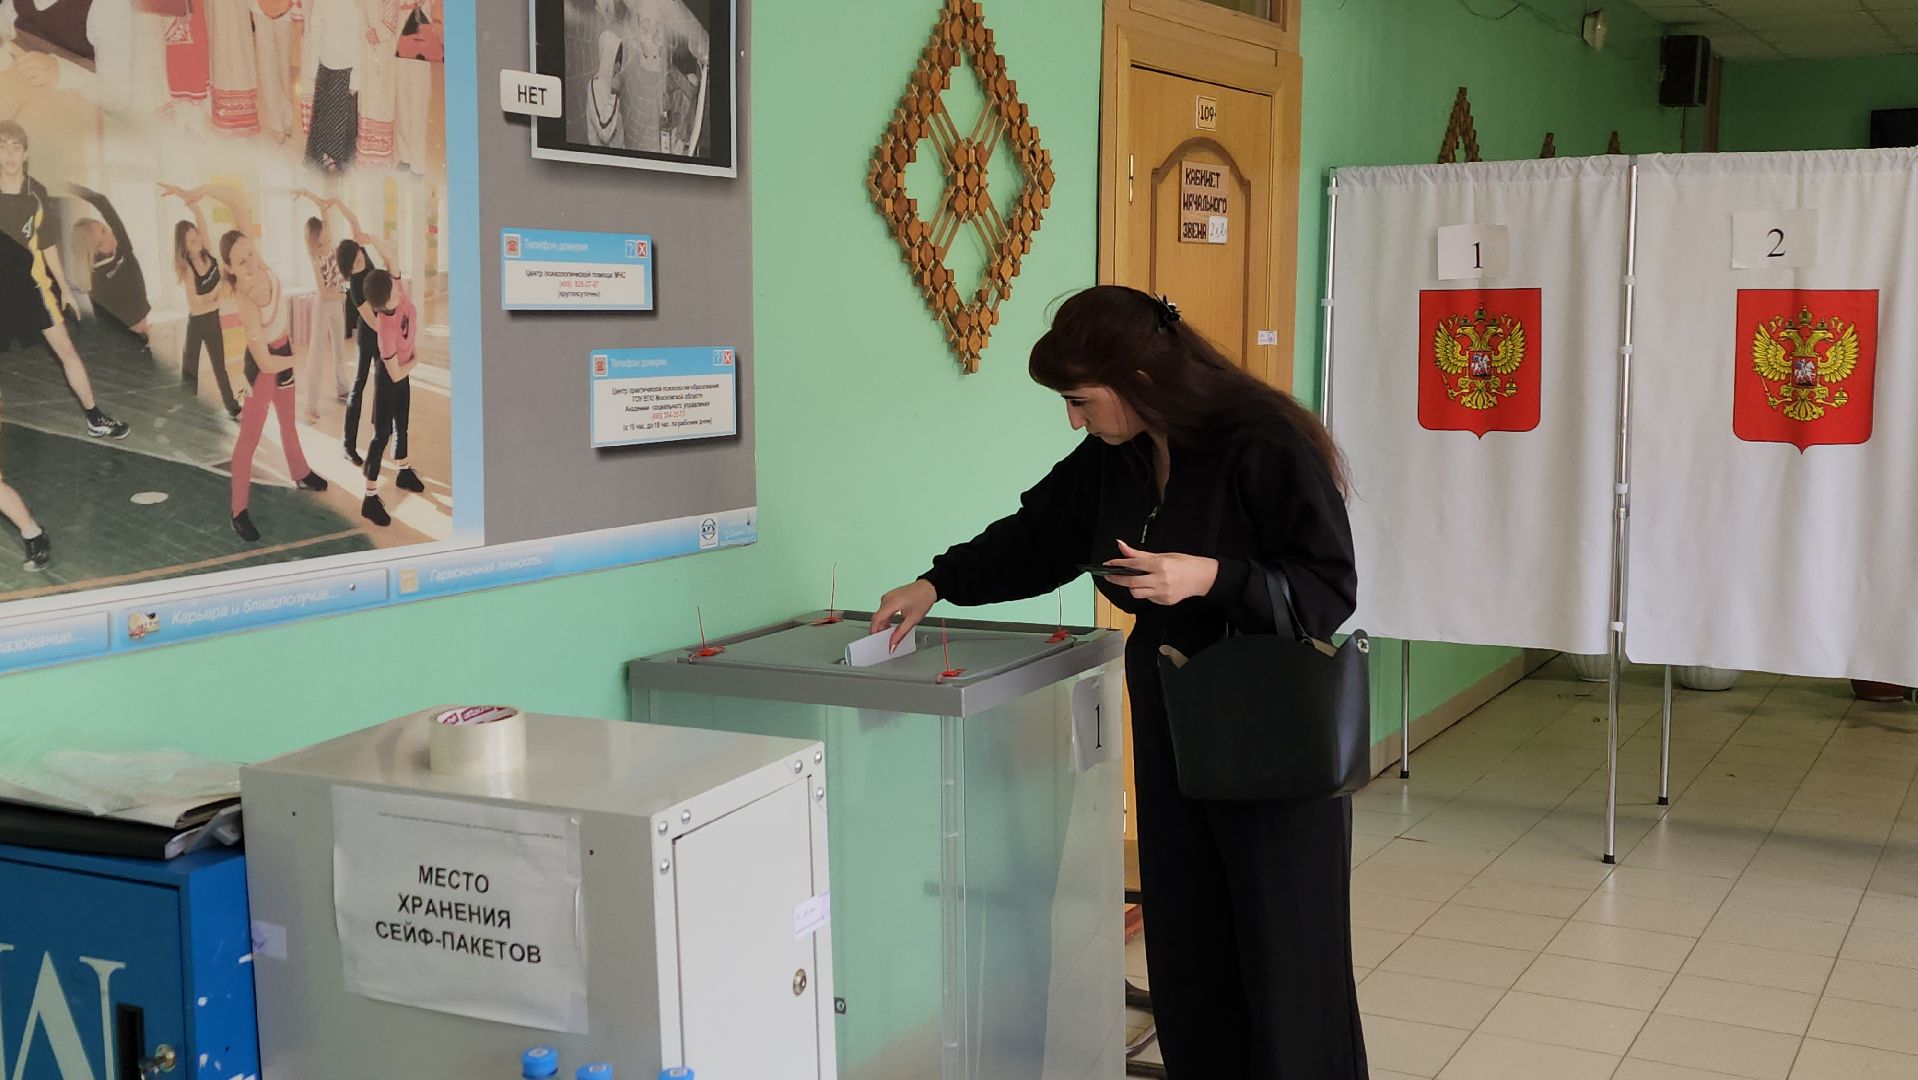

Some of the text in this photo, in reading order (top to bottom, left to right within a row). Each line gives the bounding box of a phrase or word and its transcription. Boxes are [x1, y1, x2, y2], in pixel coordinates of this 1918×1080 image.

[517, 84, 547, 106] НЕТ
[1185, 167, 1221, 188] КАБИНЕТ
[1182, 192, 1227, 214] НАЧАЛЬНОГО
[1182, 221, 1206, 239] ЗВЕНА
[1766, 228, 1786, 257] 2
[1472, 241, 1484, 269] 1
[171, 606, 228, 626] Карьера
[231, 605, 240, 615] и
[1095, 704, 1102, 749] 1
[418, 865, 489, 893] МЕСТО
[397, 893, 511, 929] ХРАНЕНИЯ
[375, 920, 542, 964] СЕЙФ-ПАКЕТОВ
